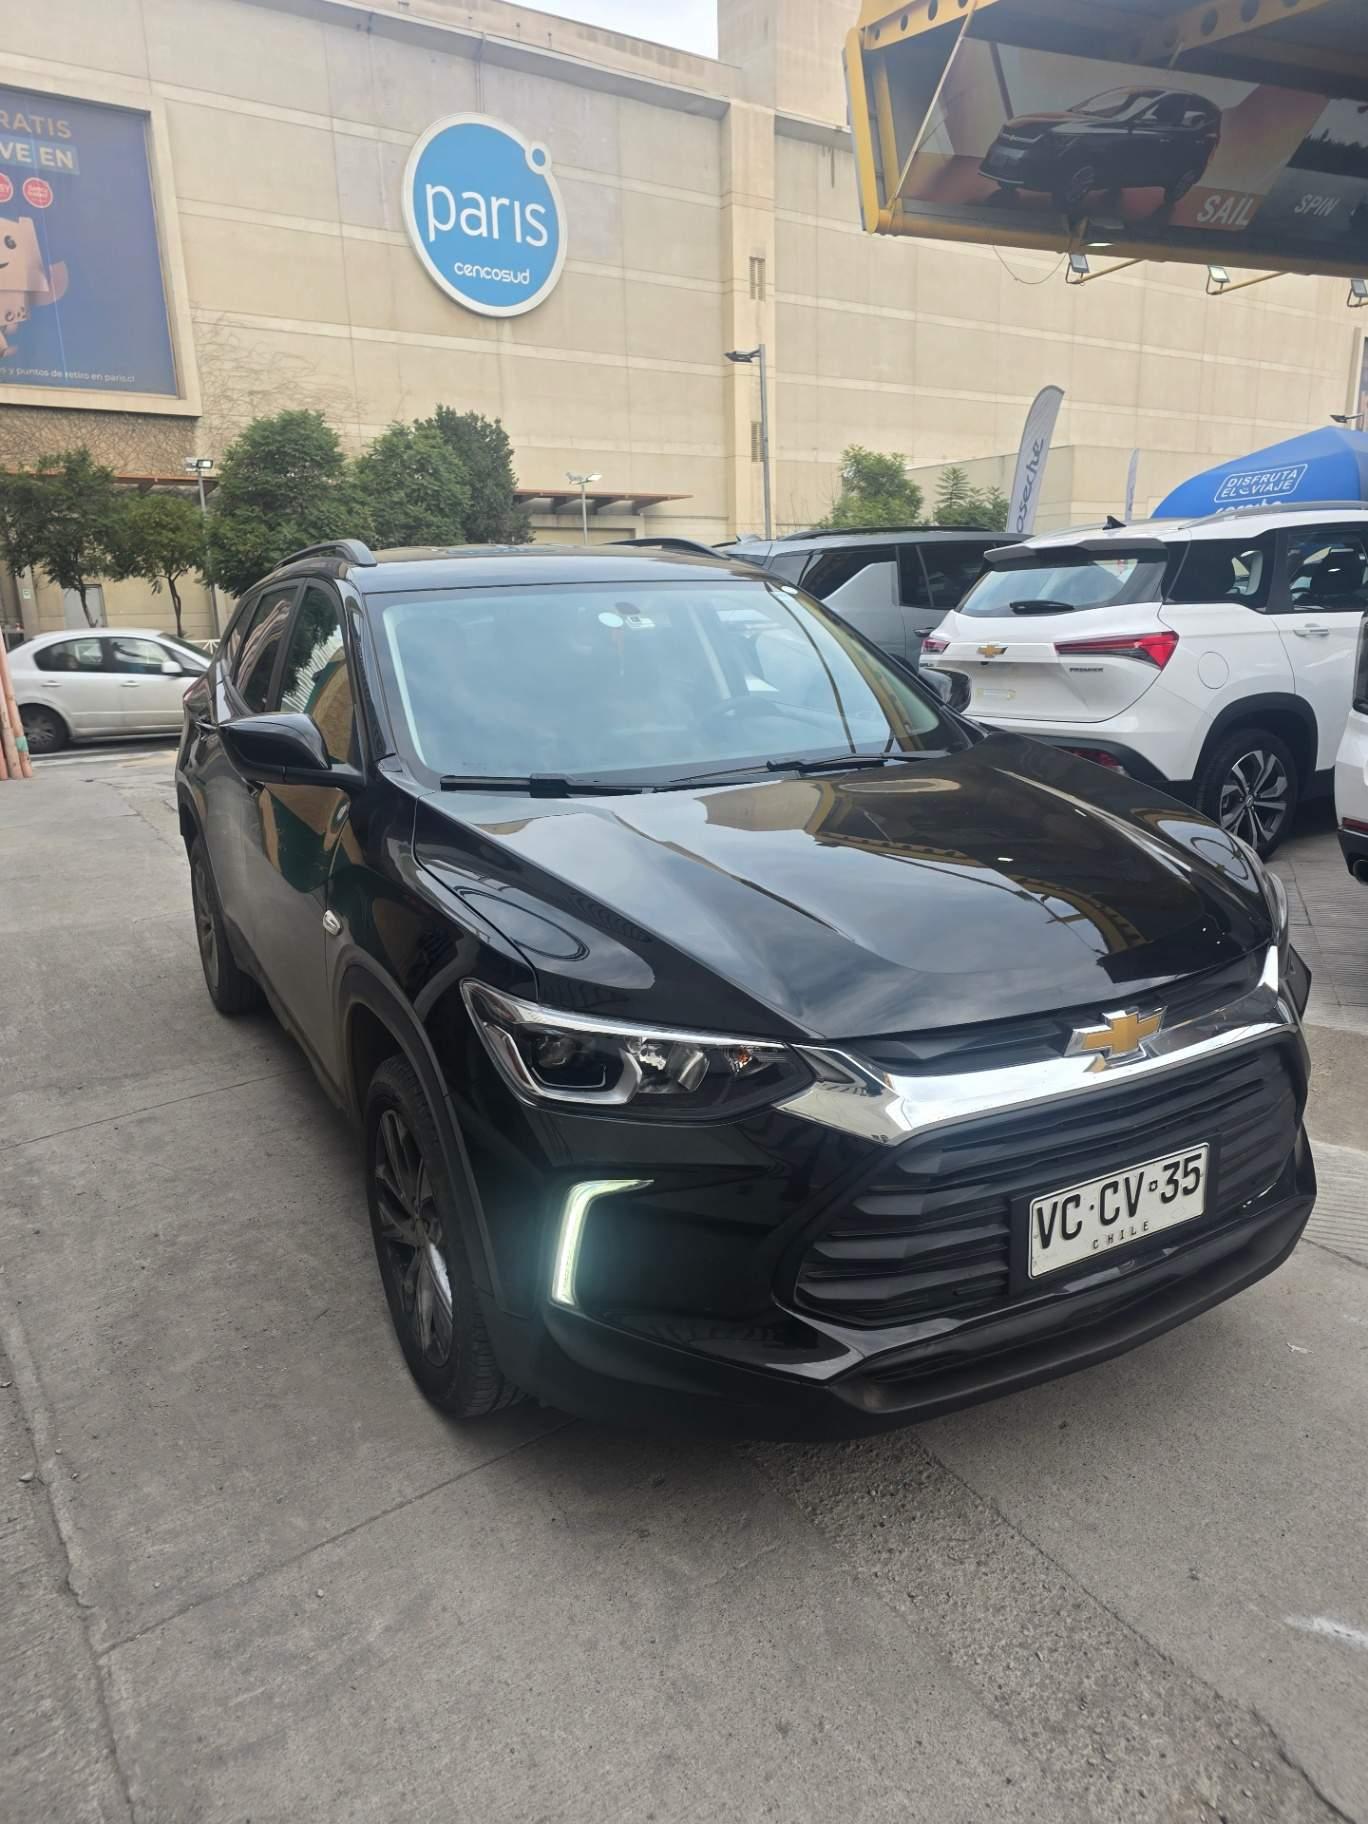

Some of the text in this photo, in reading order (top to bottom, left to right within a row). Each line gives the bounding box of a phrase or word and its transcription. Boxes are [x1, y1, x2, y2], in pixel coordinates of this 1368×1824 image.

[39, 147, 74, 169] EN
[425, 183, 548, 247] paris
[1197, 194, 1340, 226] SAIL SPIN
[454, 262, 530, 285] cencosud
[16, 367, 49, 378] puntos
[51, 369, 62, 378] de
[1220, 479, 1293, 498] EL VIAJE
[1226, 469, 1298, 488] DISFRUTA
[1092, 1221, 1149, 1250] CHILE
